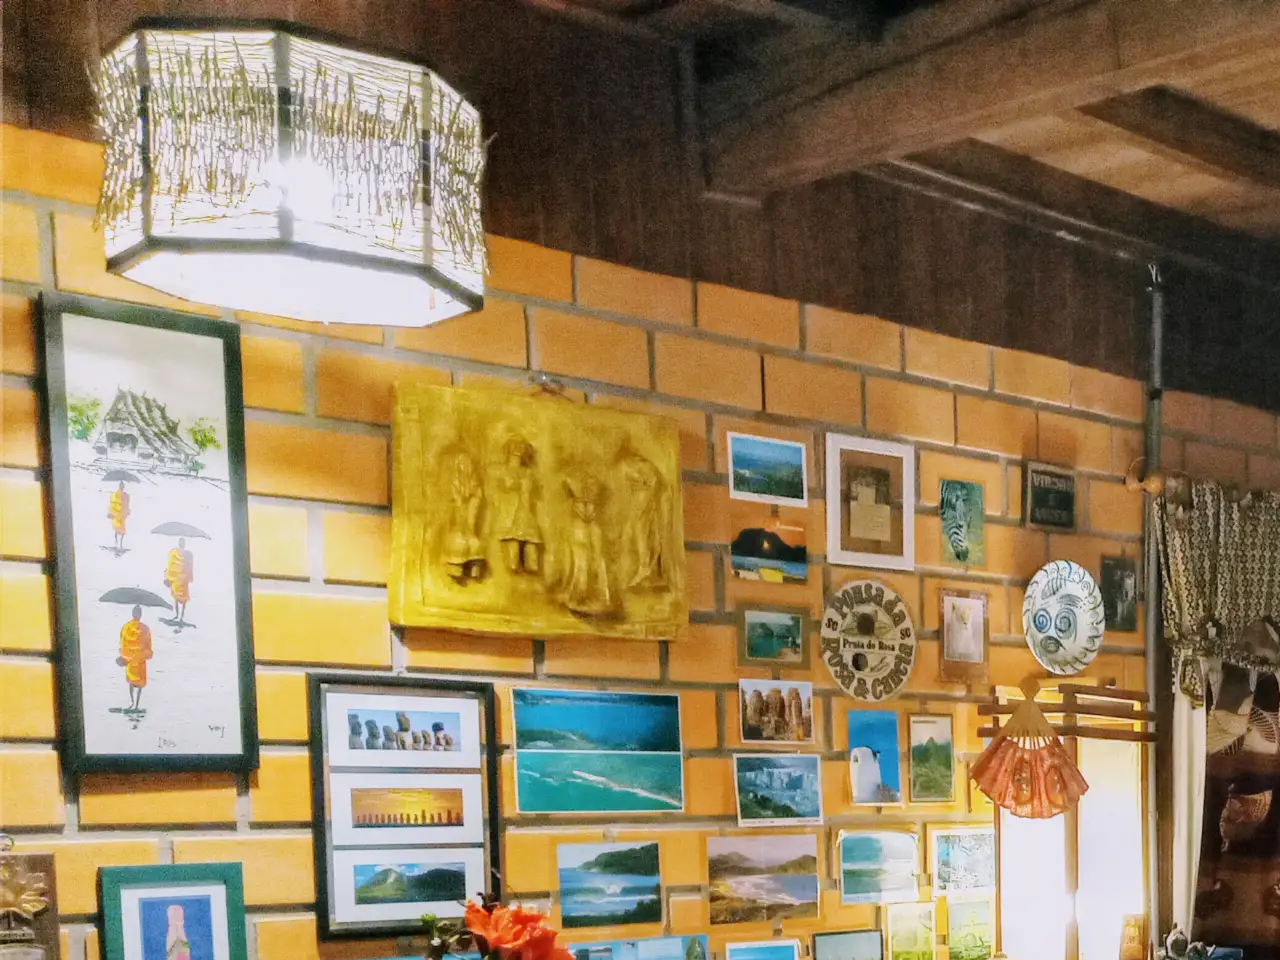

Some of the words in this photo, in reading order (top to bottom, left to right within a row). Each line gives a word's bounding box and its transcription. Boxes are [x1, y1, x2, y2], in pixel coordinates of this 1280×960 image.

[842, 638, 865, 649] Praia
[878, 640, 896, 652] Rosa
[853, 677, 870, 700] &
